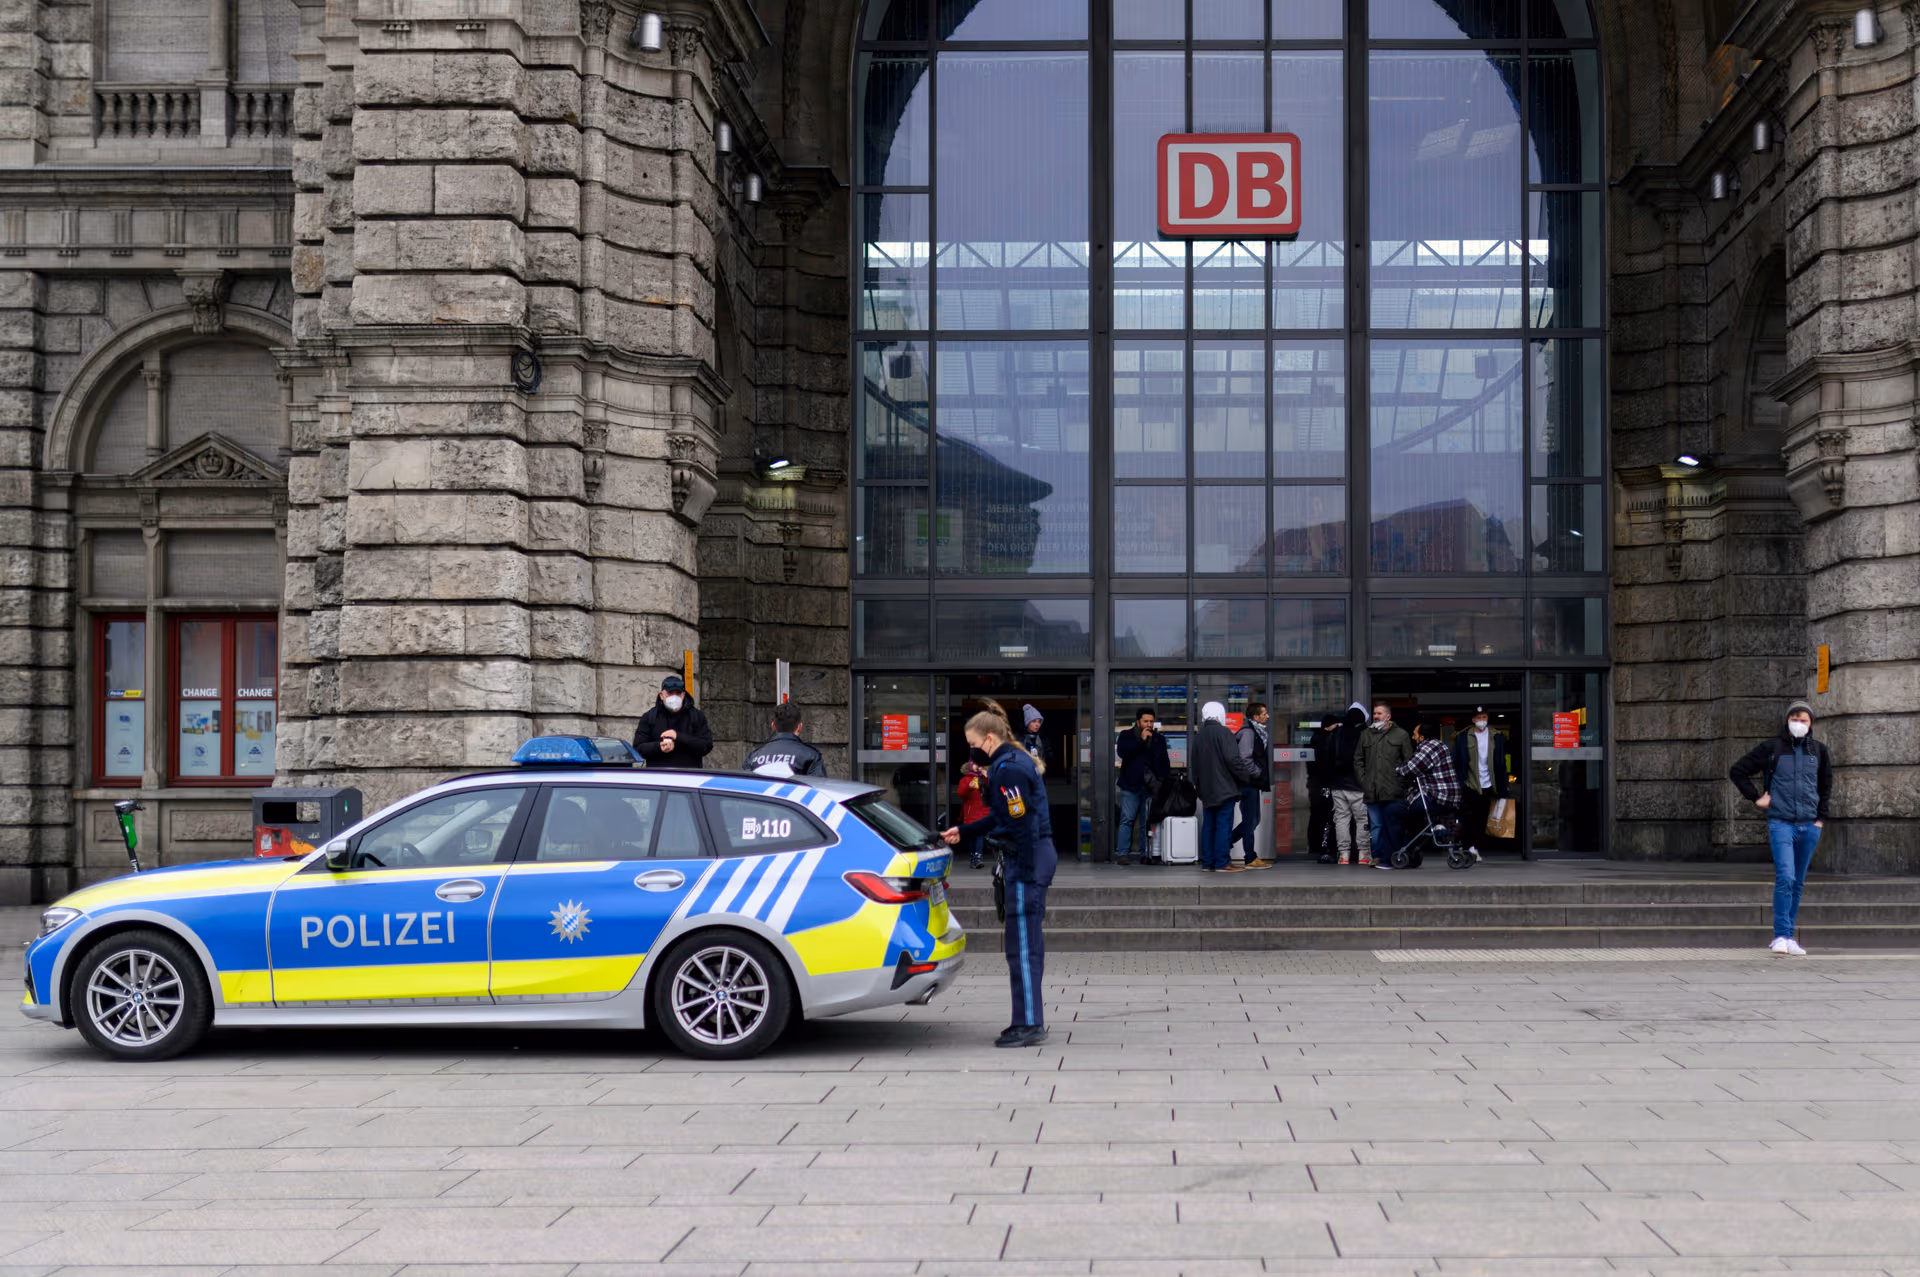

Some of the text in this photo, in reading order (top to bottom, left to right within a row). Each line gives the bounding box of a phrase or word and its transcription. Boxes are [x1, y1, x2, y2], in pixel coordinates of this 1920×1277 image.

[1179, 152, 1287, 219] DB
[182, 688, 217, 697] CHANGE
[238, 688, 273, 697] CHANGE
[752, 754, 795, 765] POLIZEI
[762, 819, 790, 838] 110
[301, 911, 455, 949] POLIZEI
